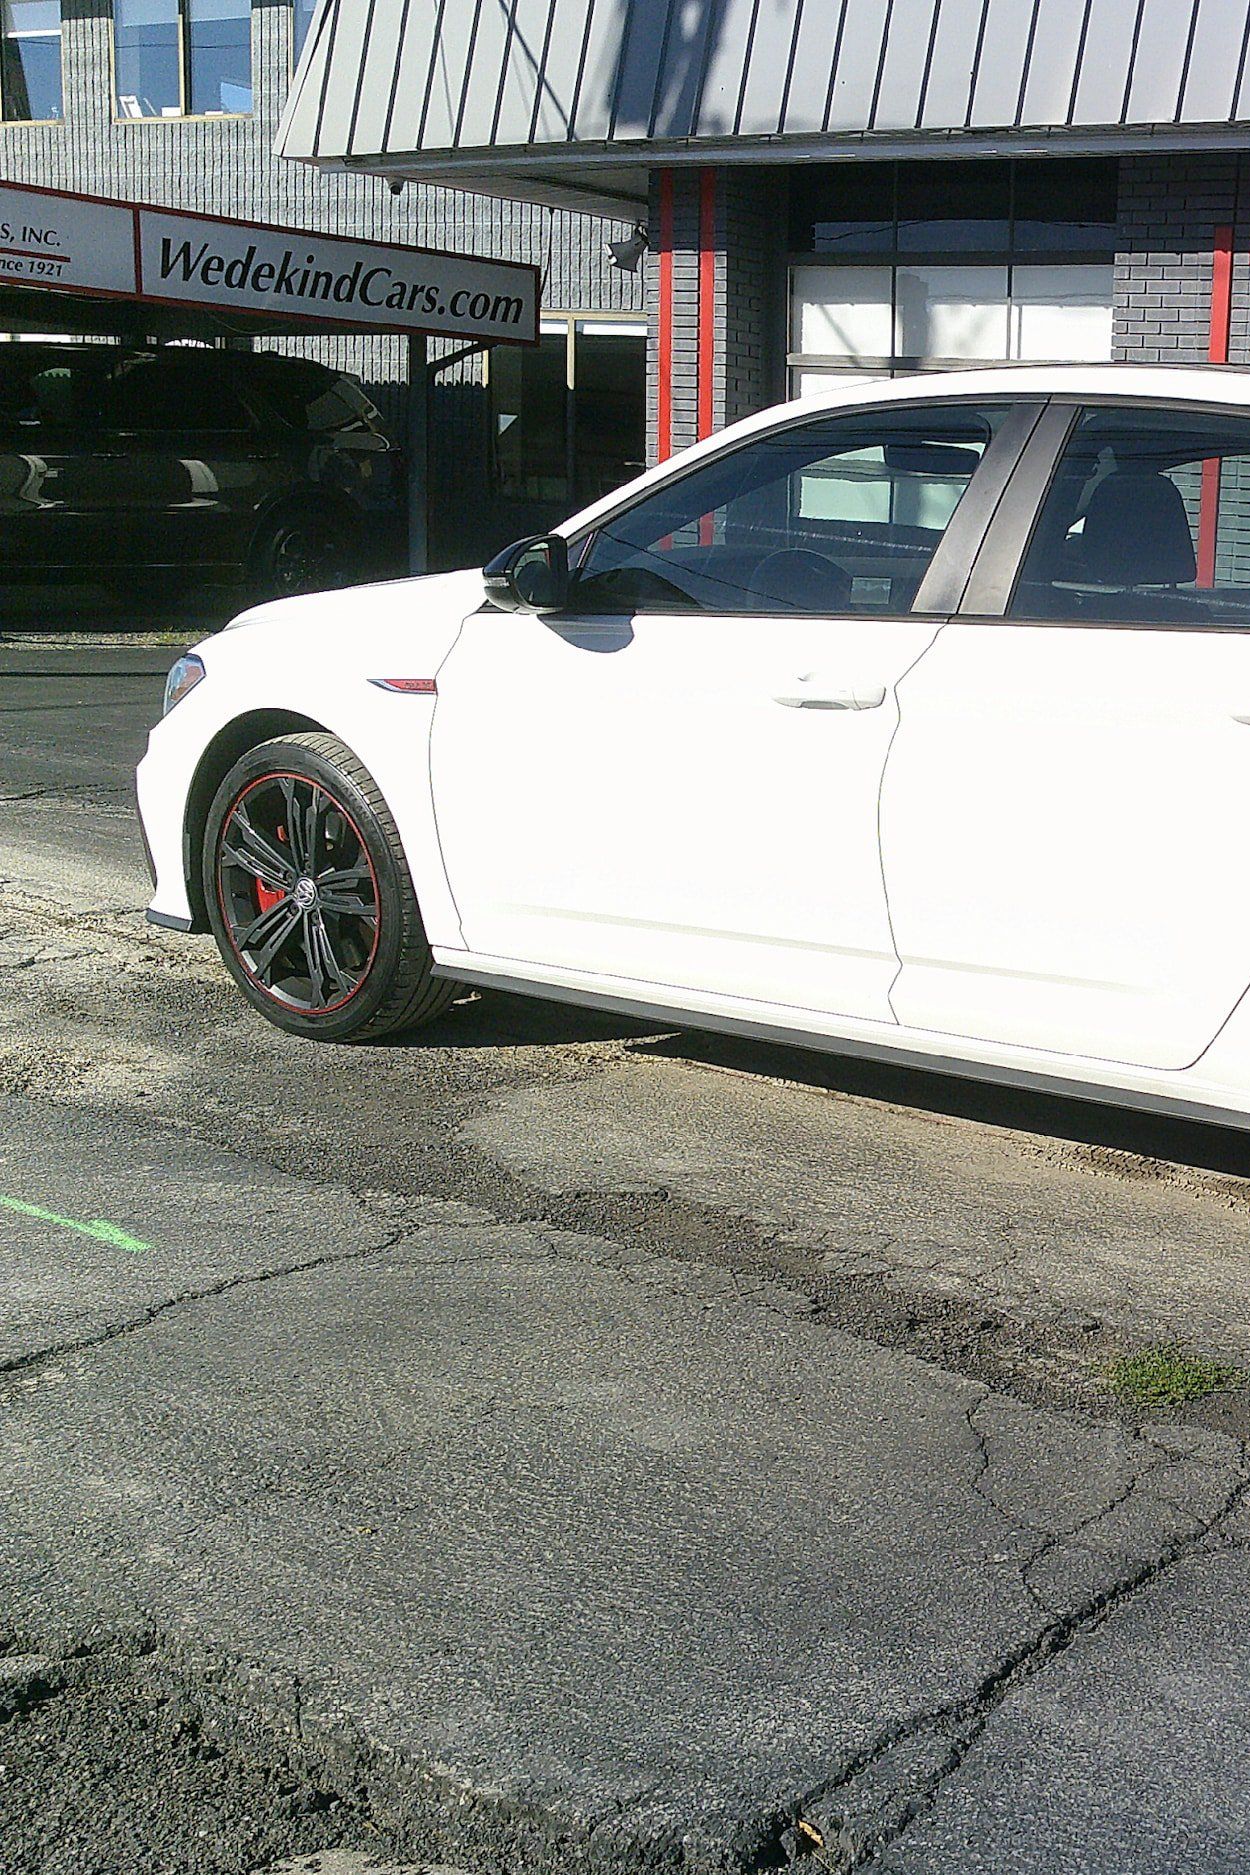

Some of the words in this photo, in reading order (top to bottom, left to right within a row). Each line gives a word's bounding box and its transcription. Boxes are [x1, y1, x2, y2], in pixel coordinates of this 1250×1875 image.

[22, 226, 61, 247] INC.
[28, 260, 62, 277] 1921
[160, 237, 524, 324] WedekindCars.com
